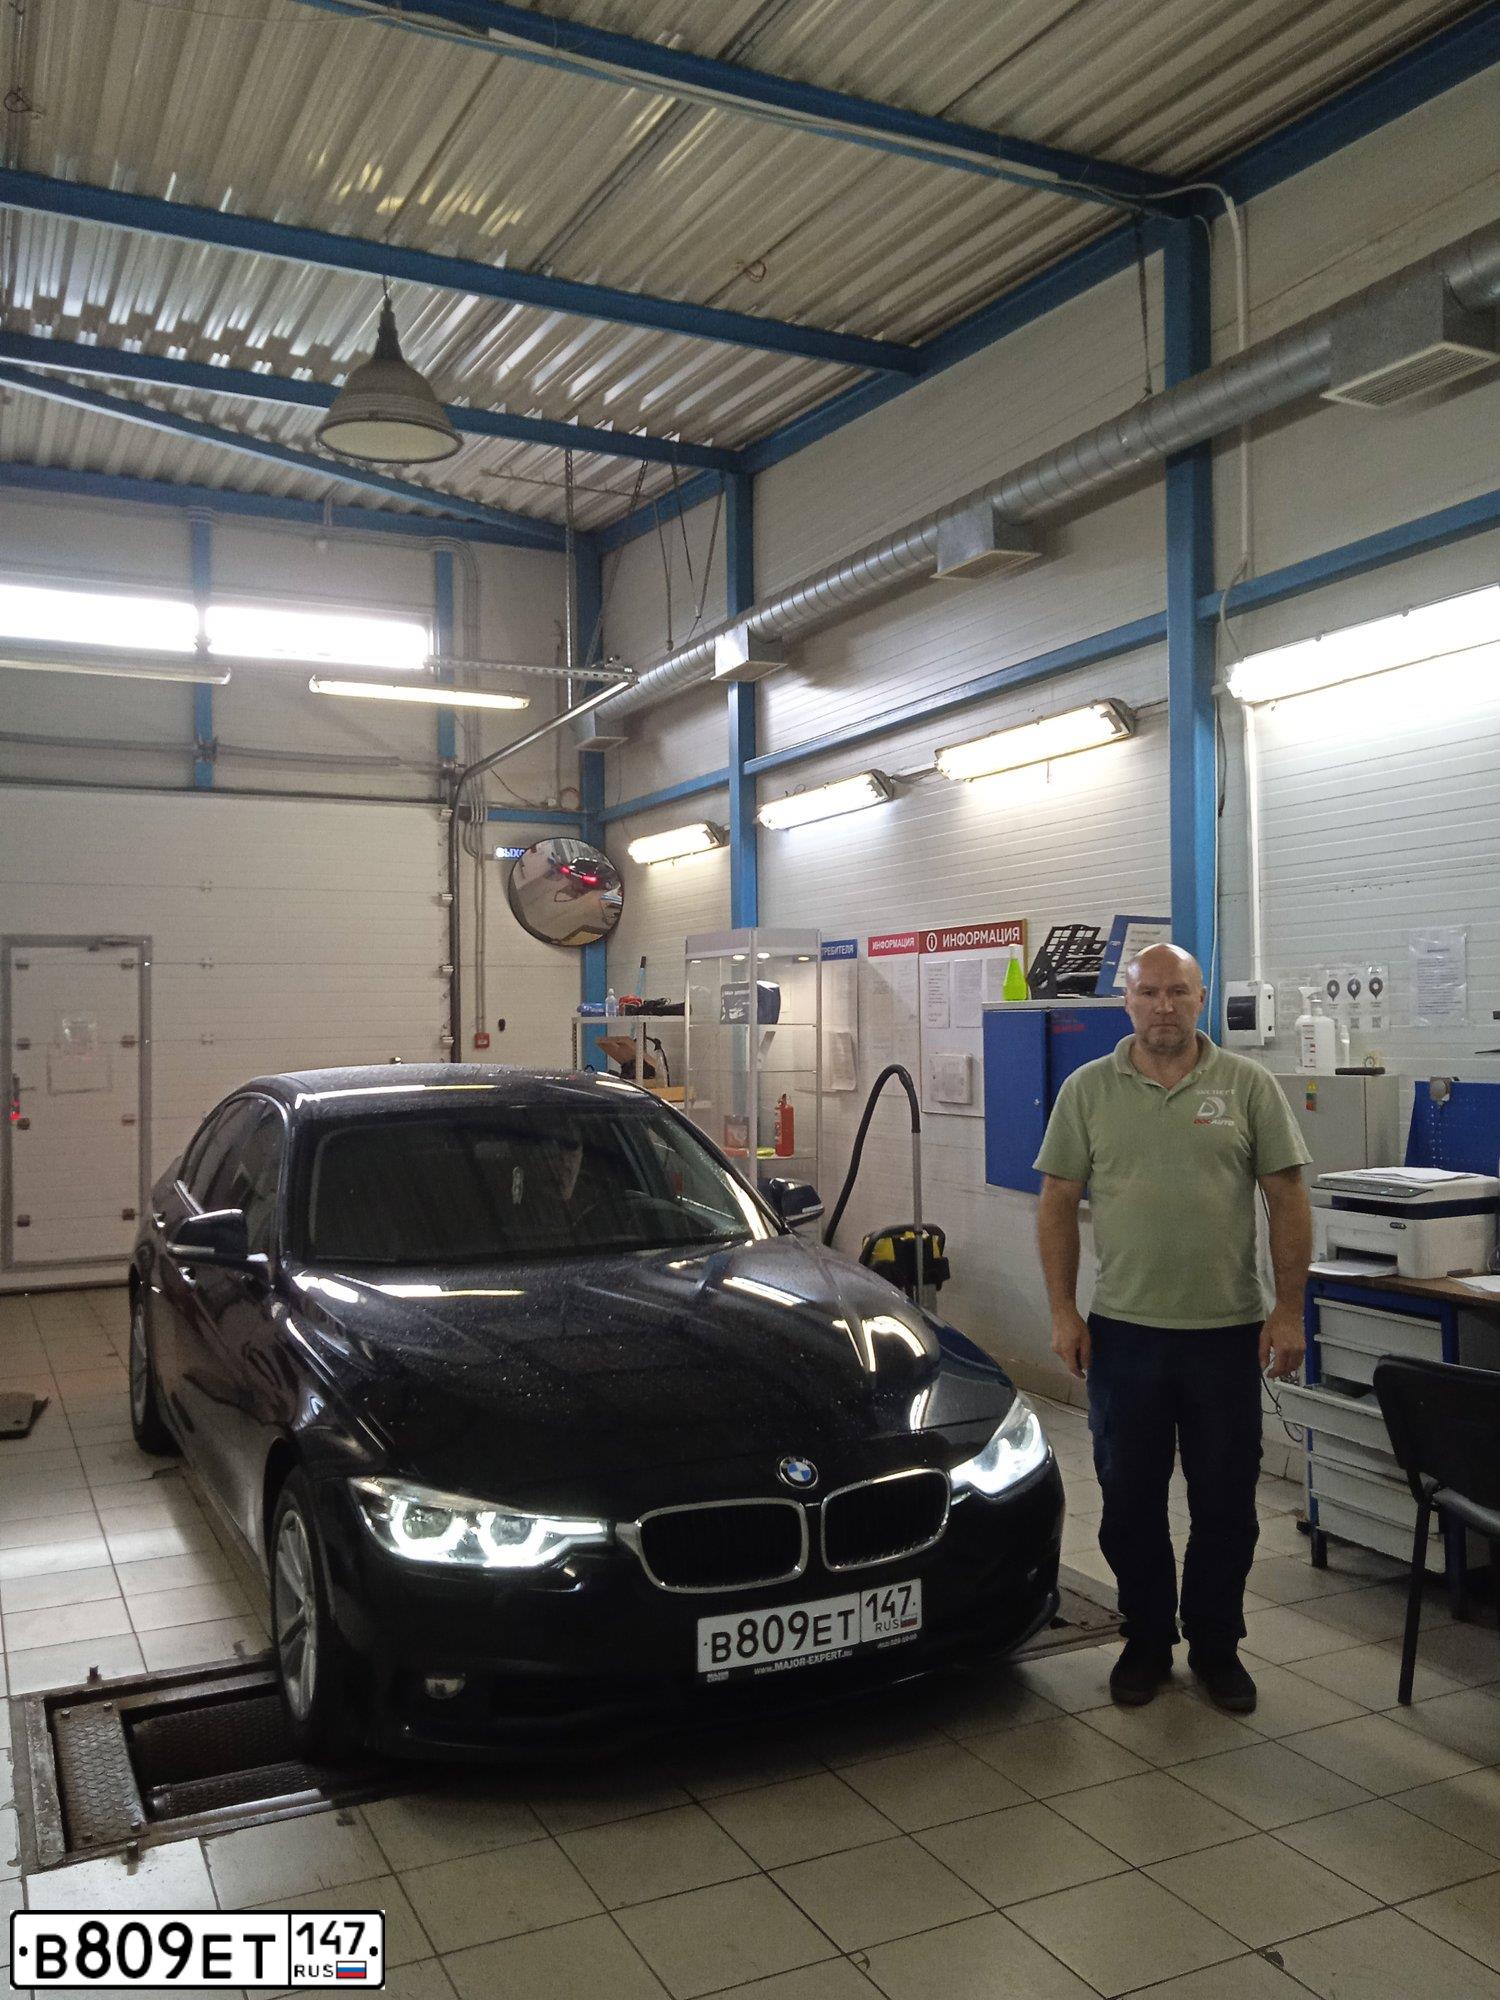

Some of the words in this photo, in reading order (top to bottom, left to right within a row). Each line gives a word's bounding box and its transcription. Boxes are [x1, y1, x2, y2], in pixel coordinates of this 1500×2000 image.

[872, 937, 915, 950] ИНФОРМАЦИЯ
[942, 926, 1020, 948] ИНФОРМАЦИЯ
[711, 1609, 855, 1664] В809ЕТ
[865, 1585, 912, 1622] 147
[875, 1618, 900, 1633] RUS
